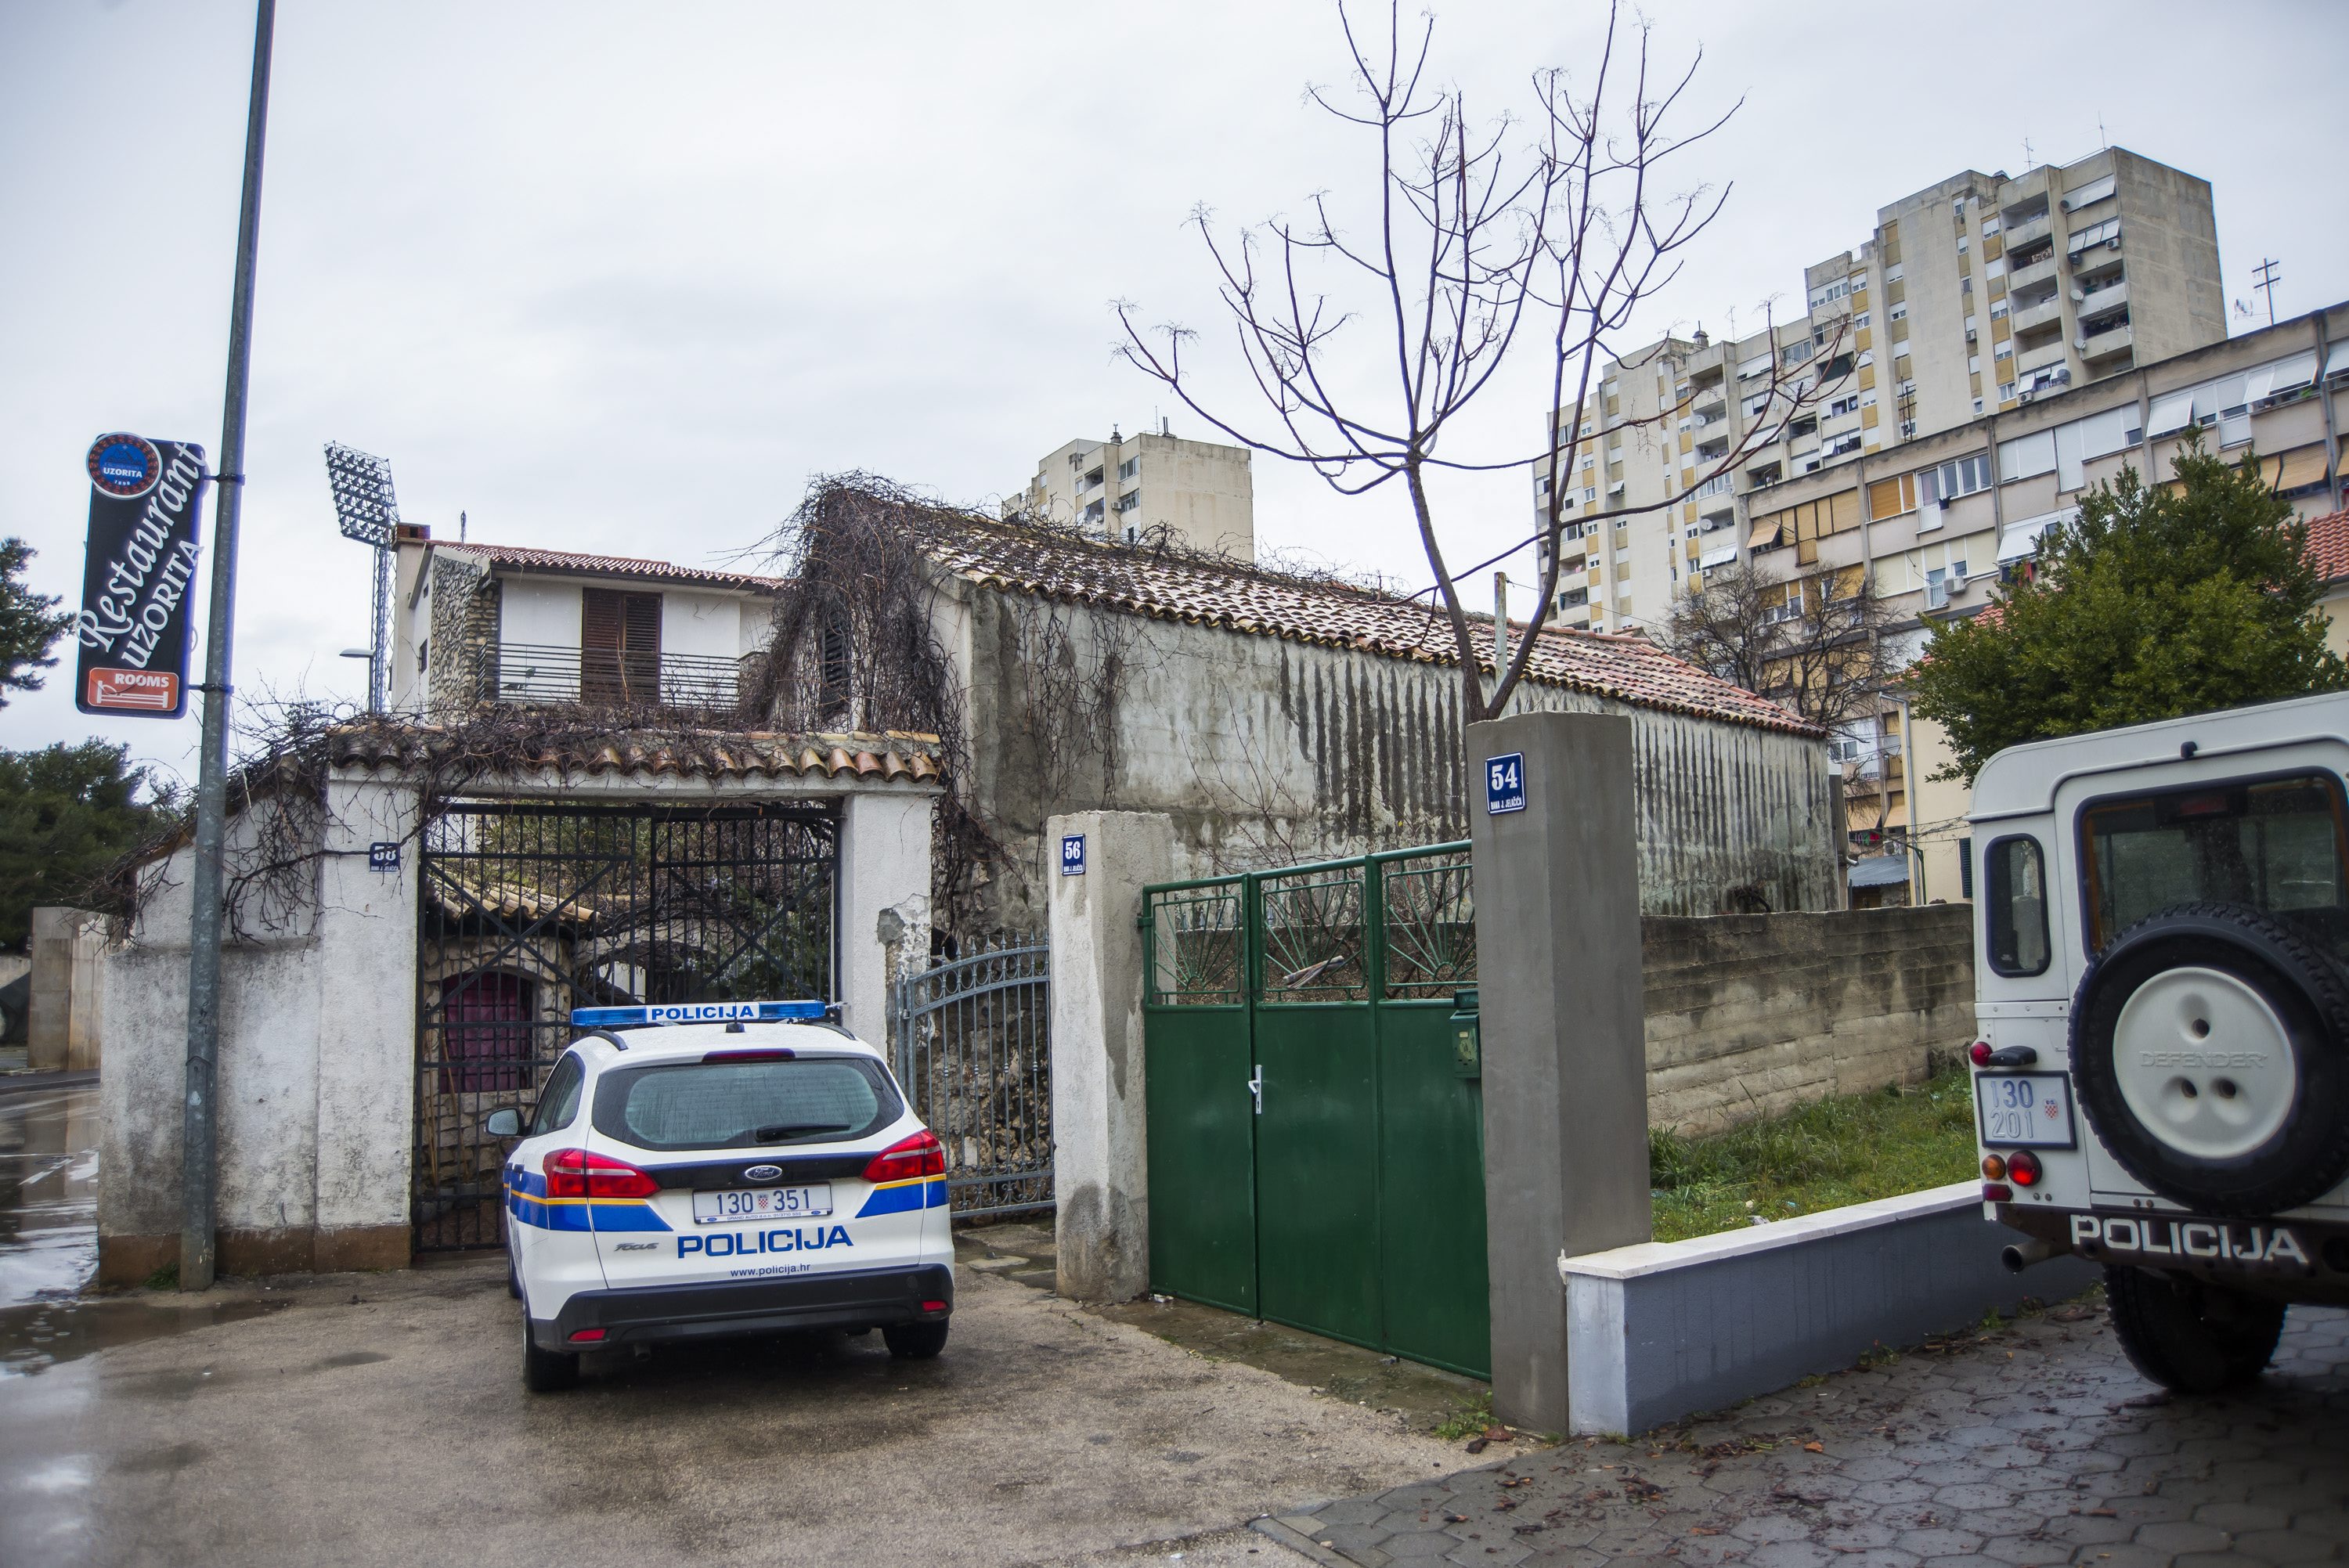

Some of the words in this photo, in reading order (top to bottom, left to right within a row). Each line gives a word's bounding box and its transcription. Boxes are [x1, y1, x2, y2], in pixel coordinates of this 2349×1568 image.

[103, 467, 143, 478] UZORITA
[77, 442, 207, 653] Restaurant
[121, 540, 205, 669] UZORITA
[114, 673, 170, 688] ROOMS
[1491, 762, 1517, 791] 54
[1065, 841, 1081, 860] 56
[651, 1005, 754, 1020] POLICIJA
[2138, 1051, 2268, 1069] DEFENDER
[1990, 1080, 2033, 1108] 130
[1990, 1108, 2033, 1139] 201
[716, 1191, 753, 1215] 130
[773, 1188, 810, 1211] 351
[677, 1225, 854, 1259] POLICIJA
[2069, 1214, 2309, 1264] POLICIJA
[730, 1263, 811, 1277] www.policija.hr
